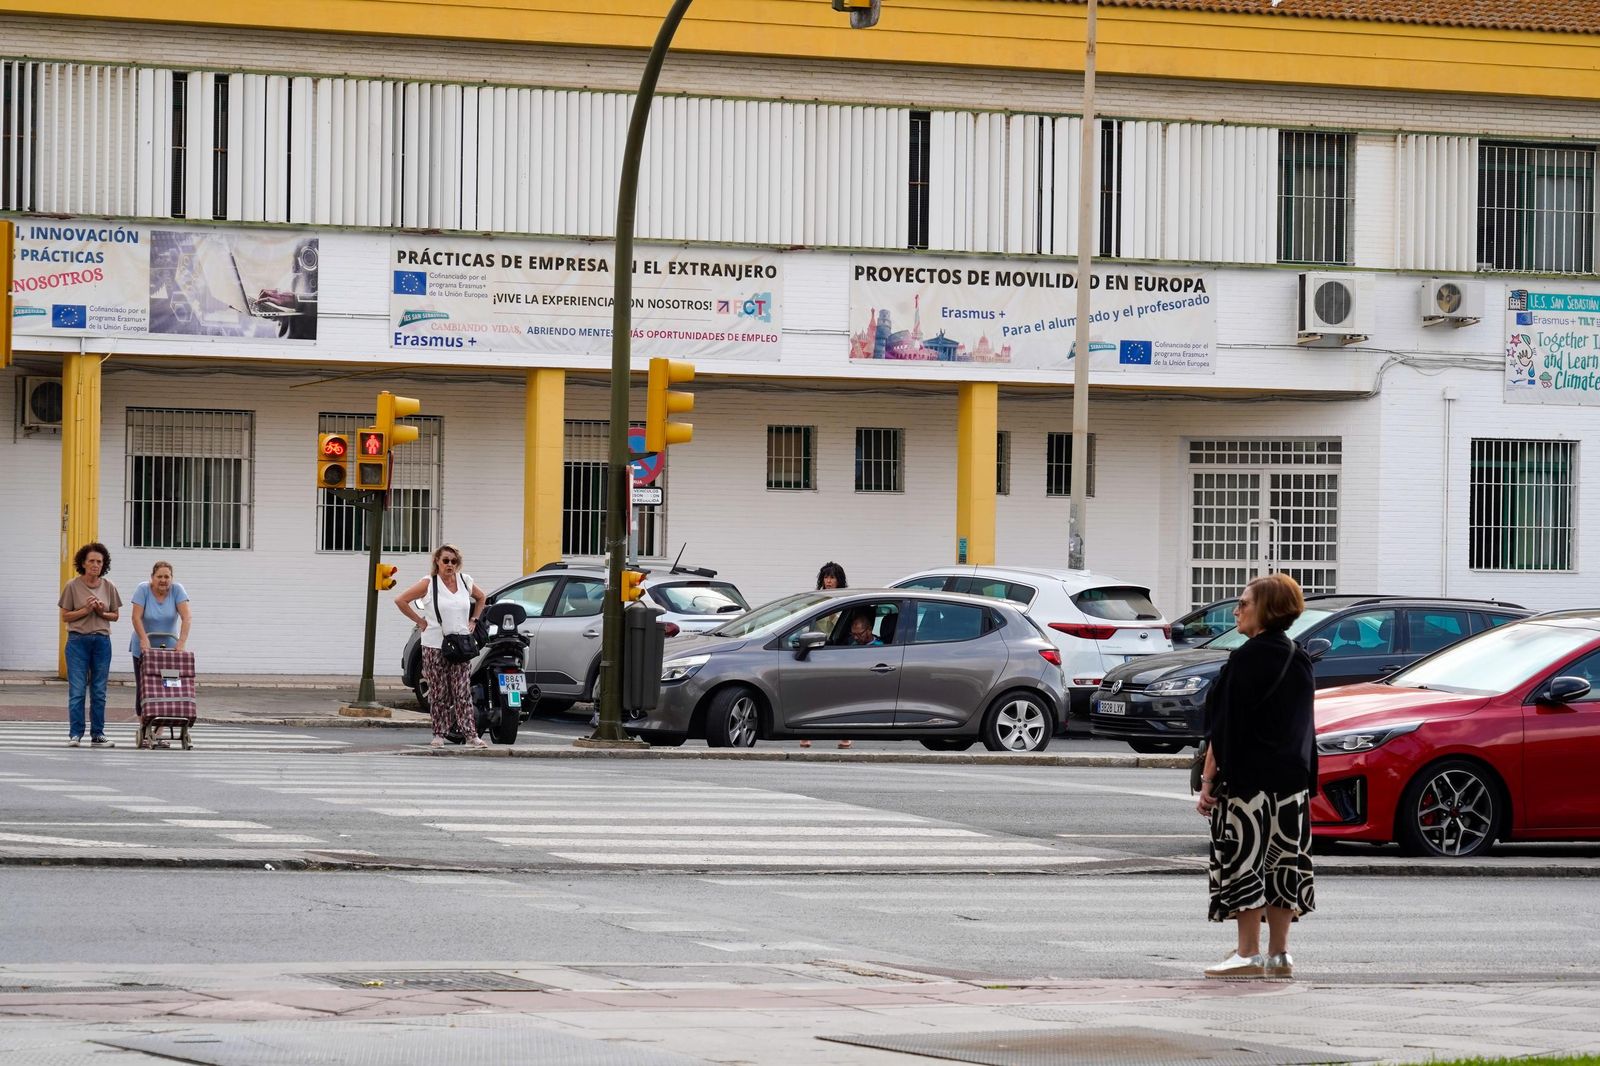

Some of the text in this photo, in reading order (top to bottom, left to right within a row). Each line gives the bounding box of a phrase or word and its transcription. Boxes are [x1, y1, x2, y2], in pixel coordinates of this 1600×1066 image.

[30, 226, 139, 244] INNOVACIÓN
[20, 246, 104, 264] PRÁCTICAS
[396, 248, 495, 268] PRÁCTICAS
[501, 254, 522, 269] DE
[529, 256, 609, 272] EMPRESA
[643, 260, 662, 275] EL
[668, 261, 777, 281] EXTRANJERO
[13, 268, 104, 293] NOSOTROS
[429, 272, 467, 280] Cofinanciado
[468, 274, 480, 282] por
[854, 265, 1206, 293] PROYECTOS DE MOVILIDD EN EUROPA
[464, 291, 488, 299] Europea
[493, 293, 521, 305] ¡VIVE
[525, 294, 539, 304] LA
[542, 295, 614, 307] EXPERIENCIA
[648, 298, 712, 311] NOSOTROS!
[90, 305, 126, 314] Cofinanciado
[942, 307, 995, 320] Erasmus
[1002, 294, 1210, 337] Para el alumado y el profesorado
[1533, 316, 1576, 326] Erasmus+
[394, 332, 463, 347] Erasmus
[431, 322, 488, 332] CAMBIANDO
[491, 324, 521, 336] VIDAS,
[527, 326, 576, 336] ABRIENDO
[579, 328, 614, 338] MENTE
[647, 330, 724, 341] OPORTUNIDADES
[727, 333, 739, 341] DE
[741, 334, 778, 343] EMPLEO
[1155, 341, 1190, 349] Cofinanciado
[1537, 332, 1590, 353] Together
[1544, 350, 1562, 370] and
[1568, 352, 1598, 370] Learn
[1555, 370, 1600, 391] Climate
